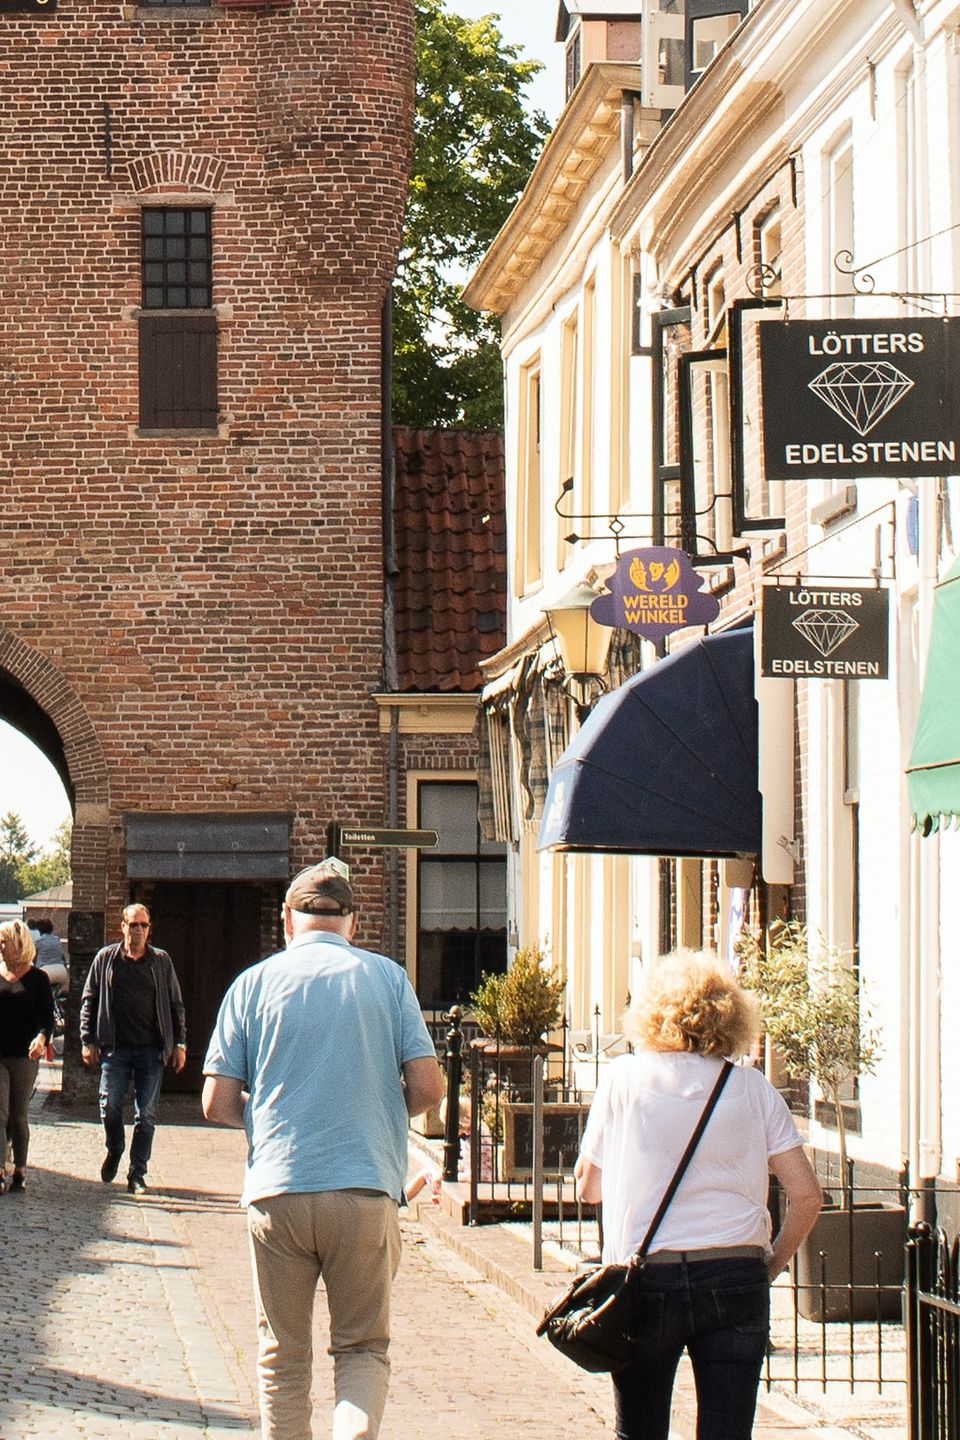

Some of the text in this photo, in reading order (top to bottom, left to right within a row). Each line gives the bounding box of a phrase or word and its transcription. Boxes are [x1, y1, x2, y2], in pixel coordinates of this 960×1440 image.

[809, 331, 925, 355] LÖTTERS
[785, 441, 956, 465] EDELSTENEN
[623, 594, 689, 609] WERELD
[789, 589, 863, 606] LÖTTERS
[624, 609, 687, 624] WINKEL
[772, 660, 879, 675] EDELSTENEN
[344, 833, 376, 841] Toiletten
